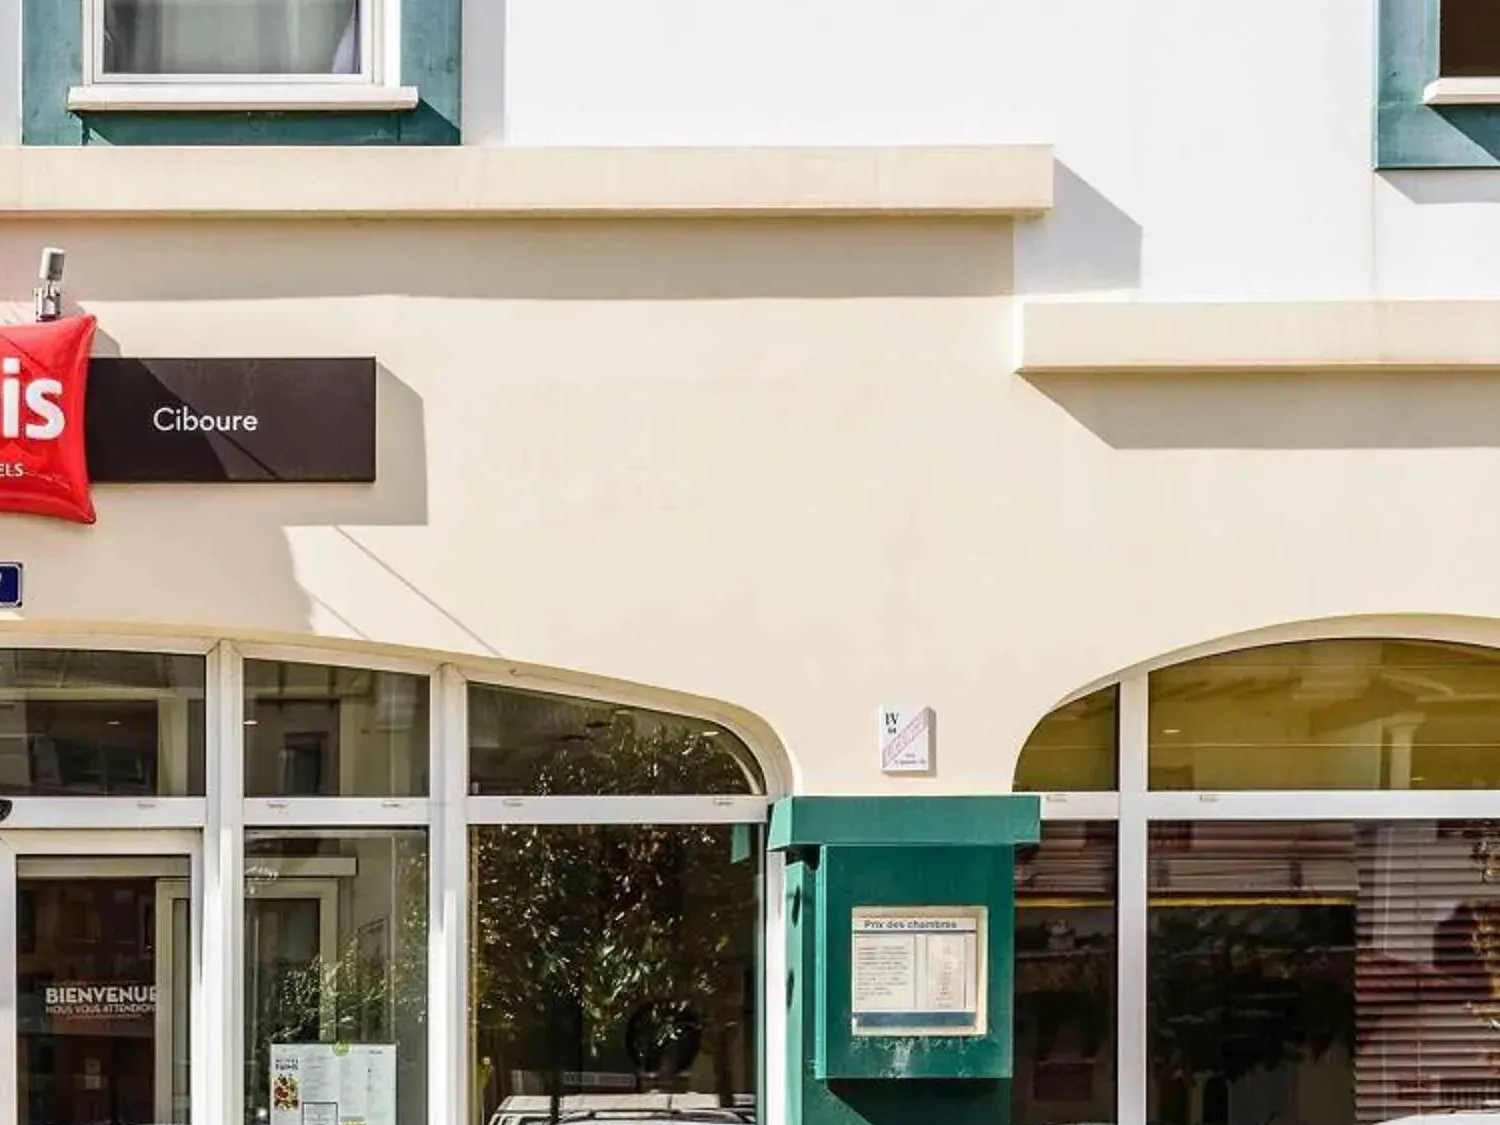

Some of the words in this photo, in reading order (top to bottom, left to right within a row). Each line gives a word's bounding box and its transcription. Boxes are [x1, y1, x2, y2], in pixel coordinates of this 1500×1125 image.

[152, 406, 259, 432] Ciboure
[864, 919, 883, 929] Prix
[886, 919, 904, 929] des
